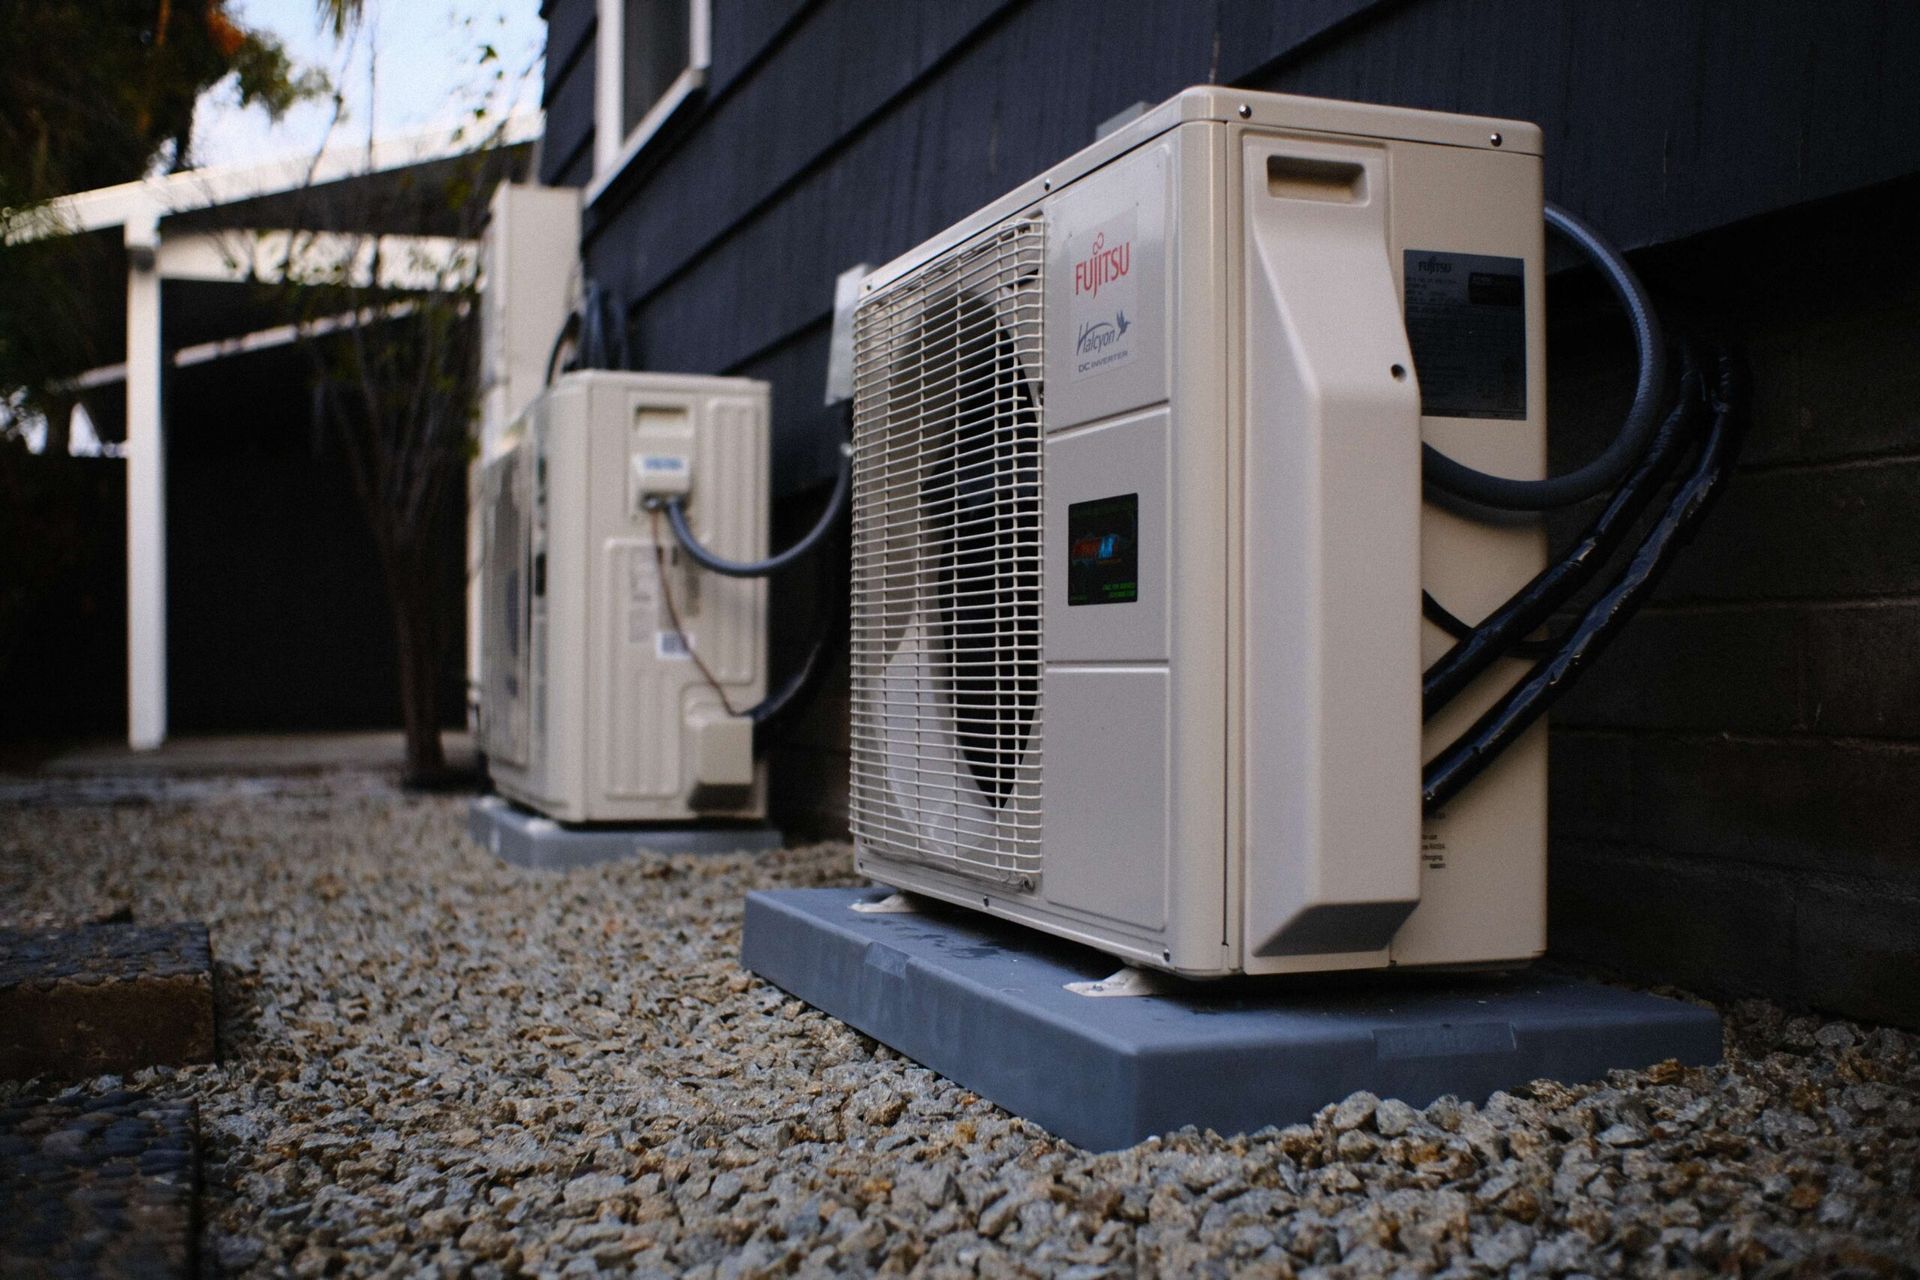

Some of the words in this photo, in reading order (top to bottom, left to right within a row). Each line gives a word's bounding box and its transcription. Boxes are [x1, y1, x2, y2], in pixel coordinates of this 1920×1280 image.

[1075, 241, 1130, 299] FUJITSU
[1076, 321, 1116, 356] Halcyon
[1078, 361, 1090, 373] DC
[1091, 350, 1129, 368] INVERTER
